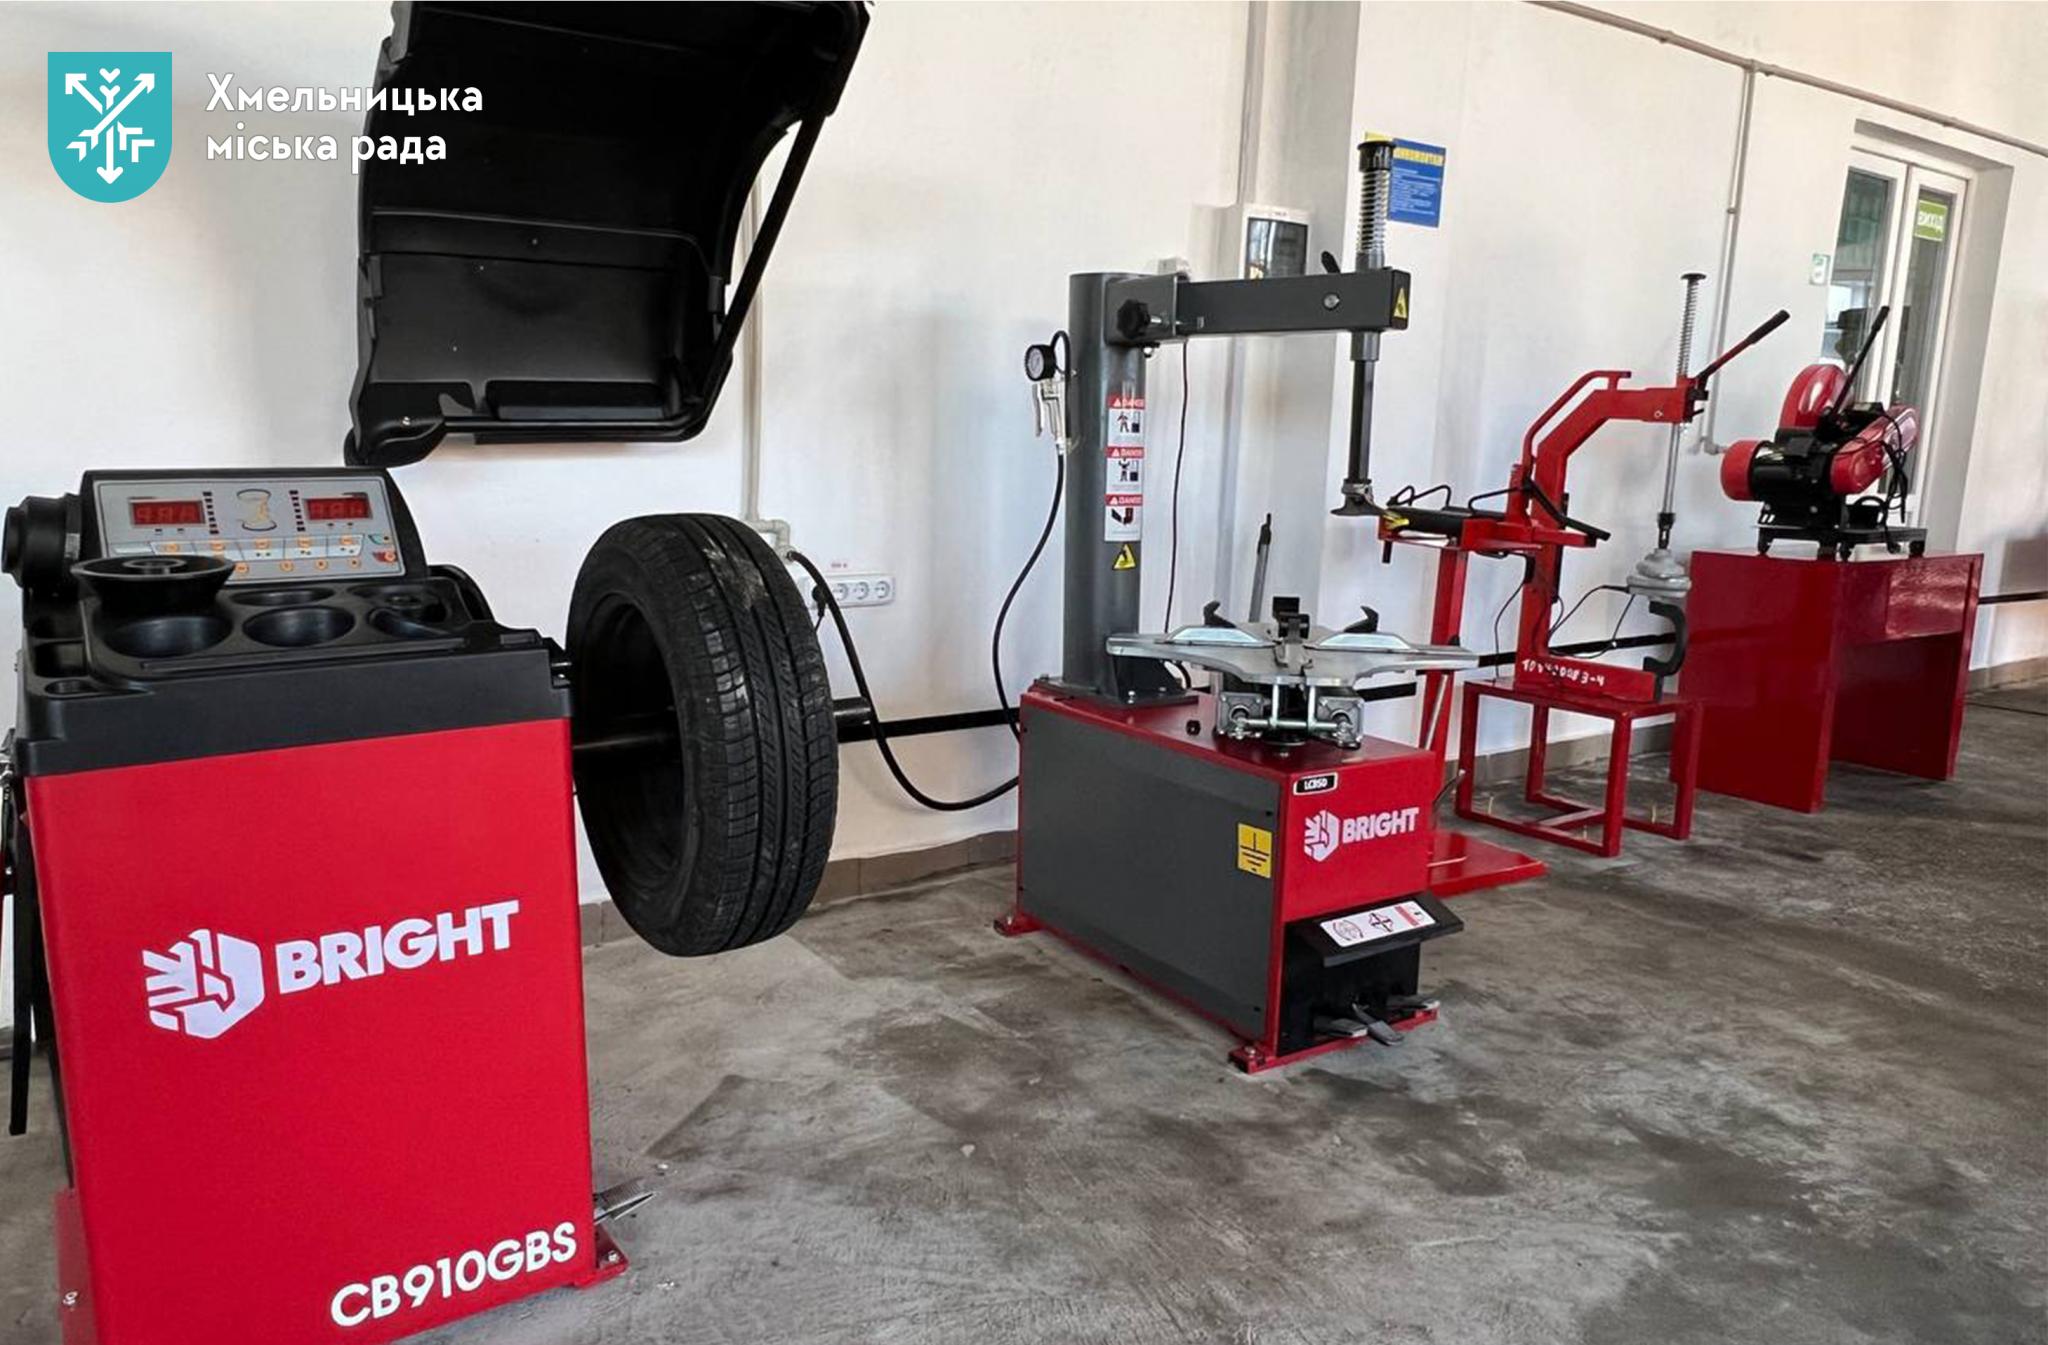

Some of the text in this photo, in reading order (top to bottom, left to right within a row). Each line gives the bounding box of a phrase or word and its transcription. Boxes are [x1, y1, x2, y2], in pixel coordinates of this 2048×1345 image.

[1342, 807, 1419, 844] BRIGHT
[275, 900, 519, 994] BRIGHT
[330, 1222, 577, 1328] CB910GBS
